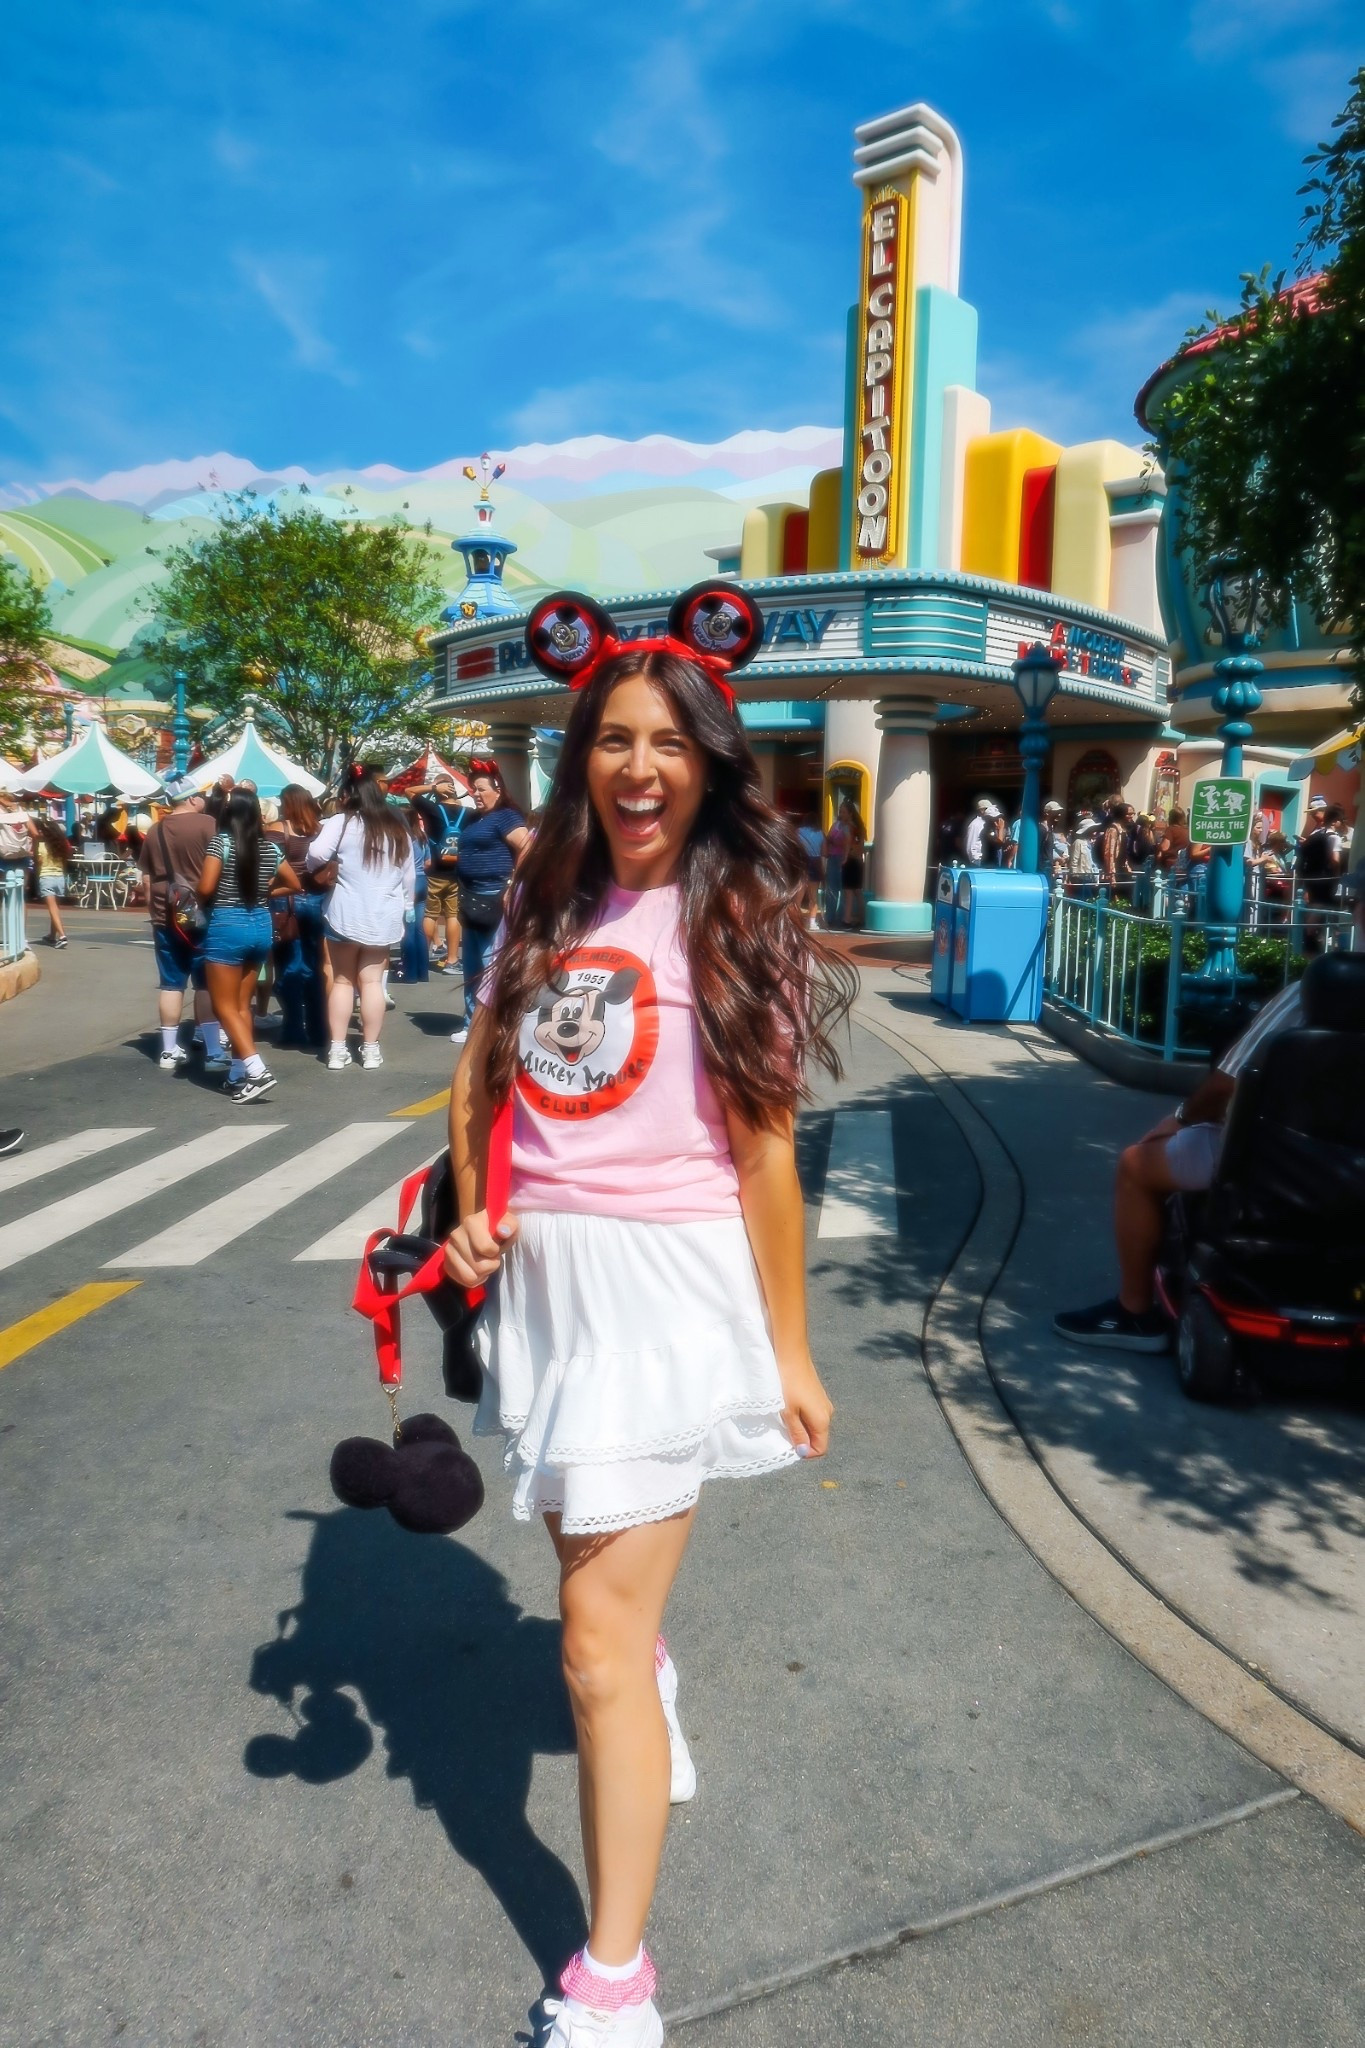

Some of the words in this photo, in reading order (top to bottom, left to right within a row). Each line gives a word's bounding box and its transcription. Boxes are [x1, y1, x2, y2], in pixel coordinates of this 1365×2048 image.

[872, 205, 895, 275] EL
[857, 282, 895, 550] CAPITOON
[1196, 821, 1225, 830] SHARE
[1228, 821, 1245, 829] THE
[1206, 831, 1232, 839] ROAD
[576, 972, 607, 985] 1955
[539, 1096, 590, 1113] CLUB
